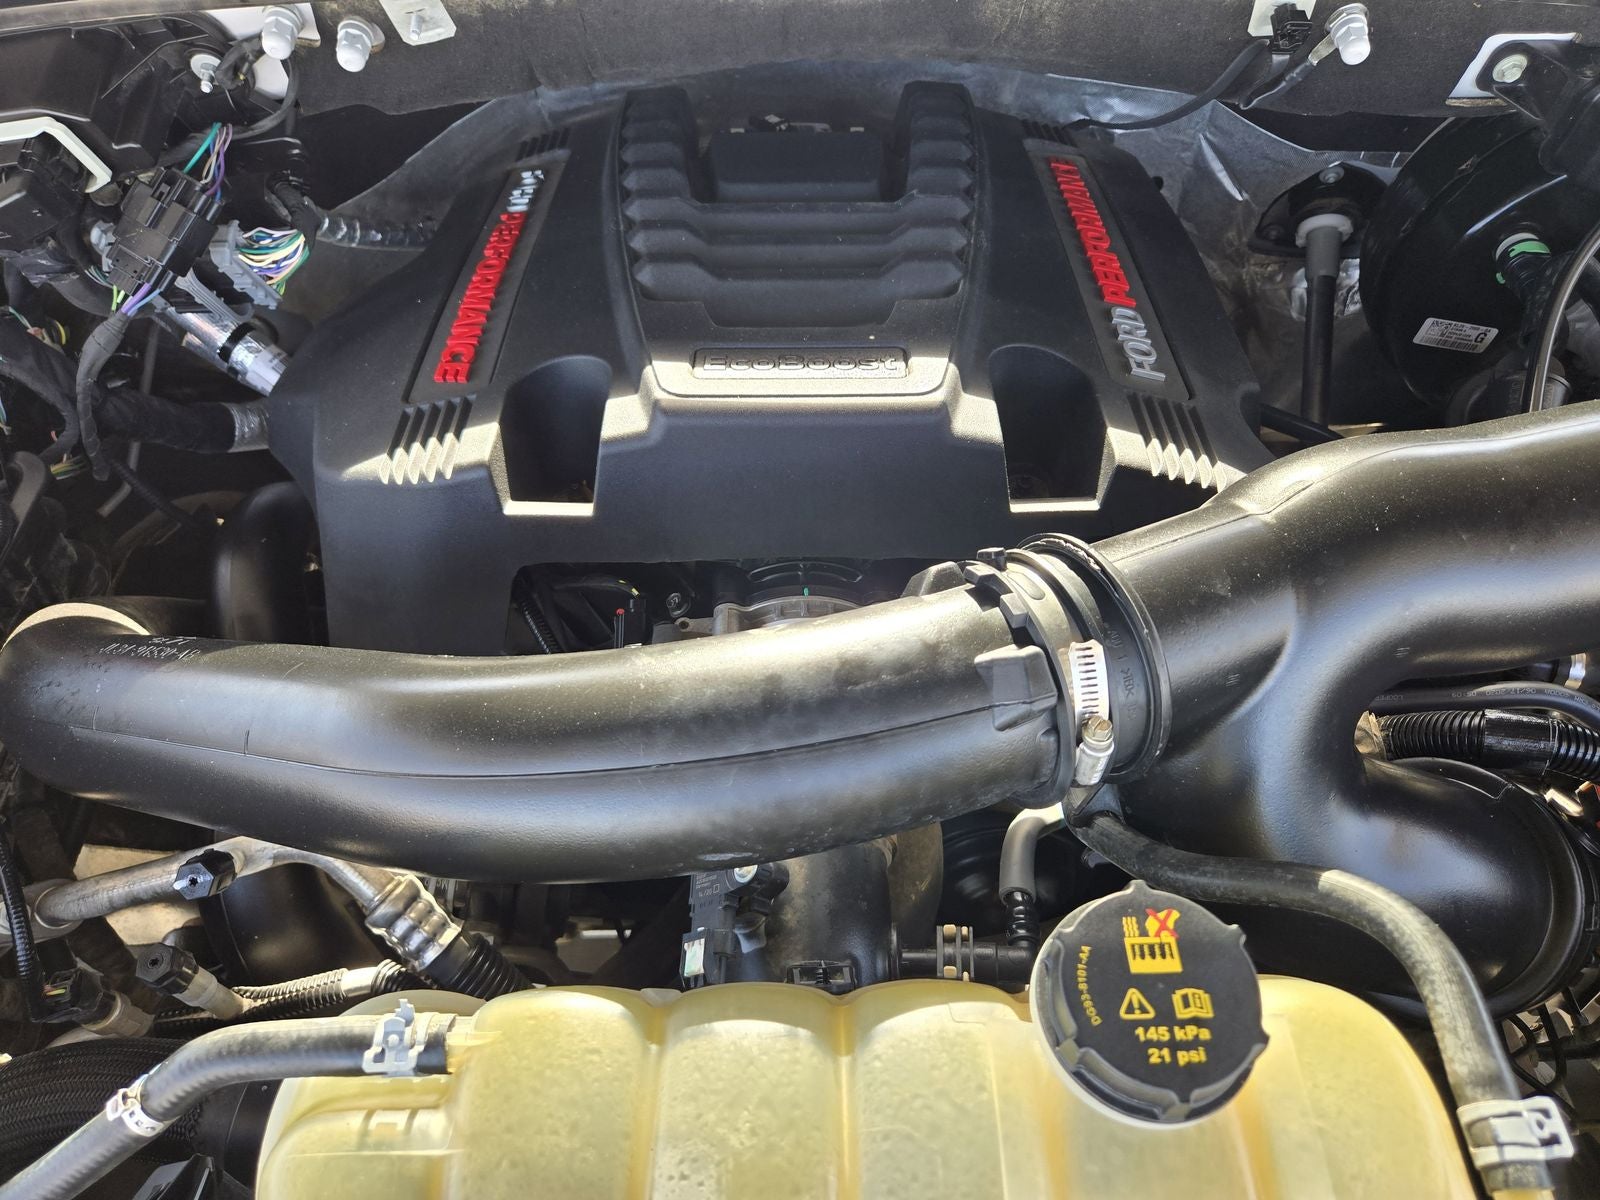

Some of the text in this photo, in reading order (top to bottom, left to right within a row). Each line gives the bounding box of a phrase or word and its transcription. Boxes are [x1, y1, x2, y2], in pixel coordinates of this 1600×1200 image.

[1048, 156, 1166, 382] FORD PERFORMANCE
[435, 211, 526, 383] PERFORMANCE
[1474, 332, 1487, 343] G
[703, 354, 898, 371] EcoBoost
[1134, 1025, 1212, 1042] 145 kPa
[1147, 1046, 1208, 1067] 21 psi
